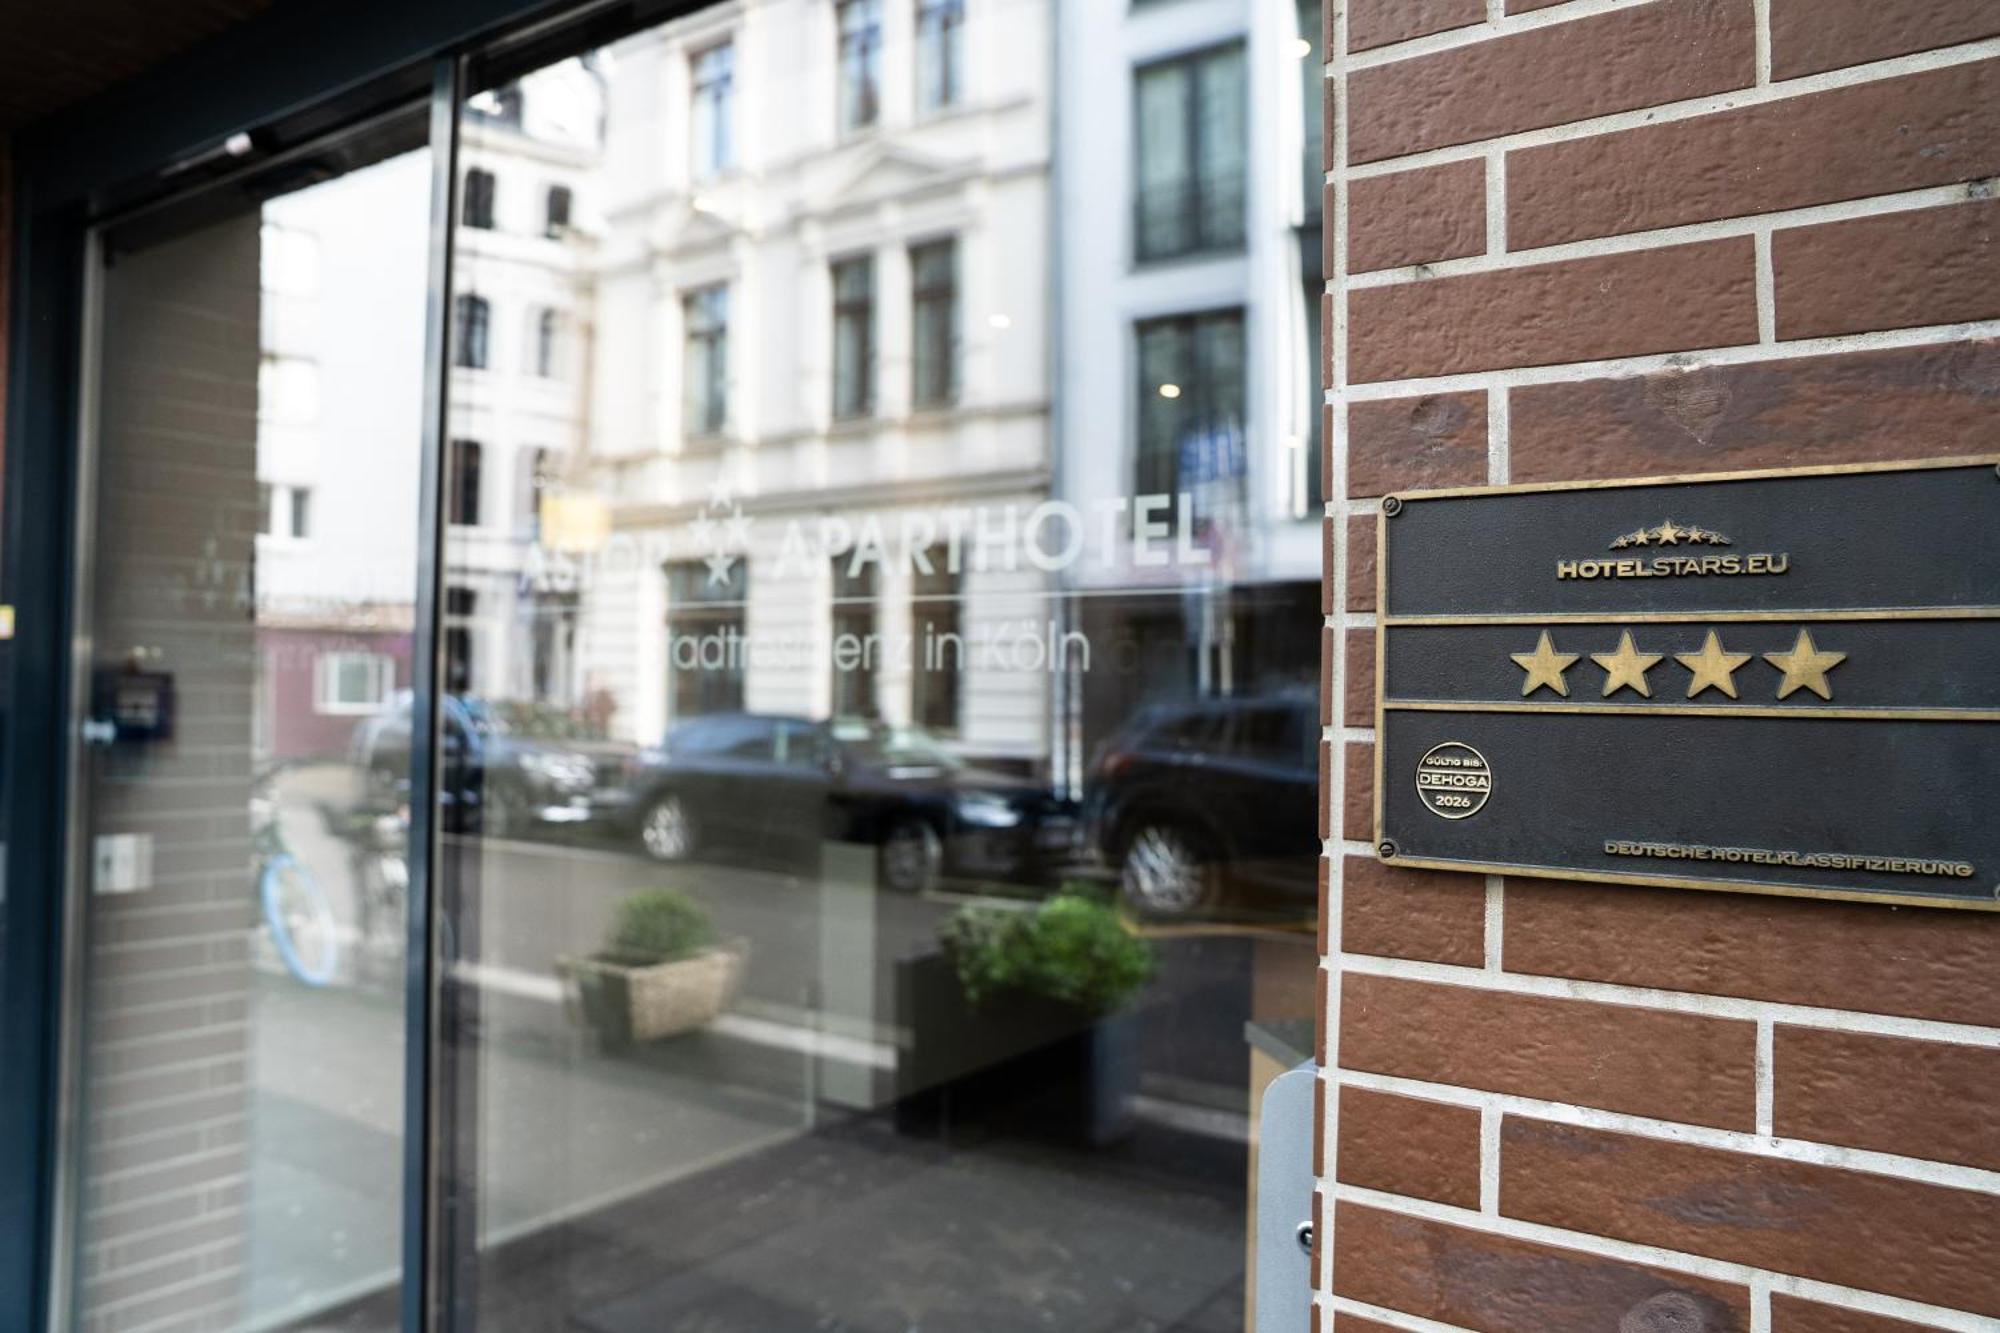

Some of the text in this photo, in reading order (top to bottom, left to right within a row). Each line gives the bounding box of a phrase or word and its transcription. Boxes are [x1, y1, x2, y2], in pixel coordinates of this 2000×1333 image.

[771, 492, 1211, 579] APARTHOTEL
[1557, 553, 1788, 578] HOTELSTARS.EU
[924, 621, 963, 671] in
[982, 620, 1090, 671] Köln
[1420, 774, 1488, 787] DEHOGA
[1435, 796, 1472, 807] 2026
[1604, 840, 1975, 878] DEUTSCHE HOTELKLASSIFIZIERUNG
